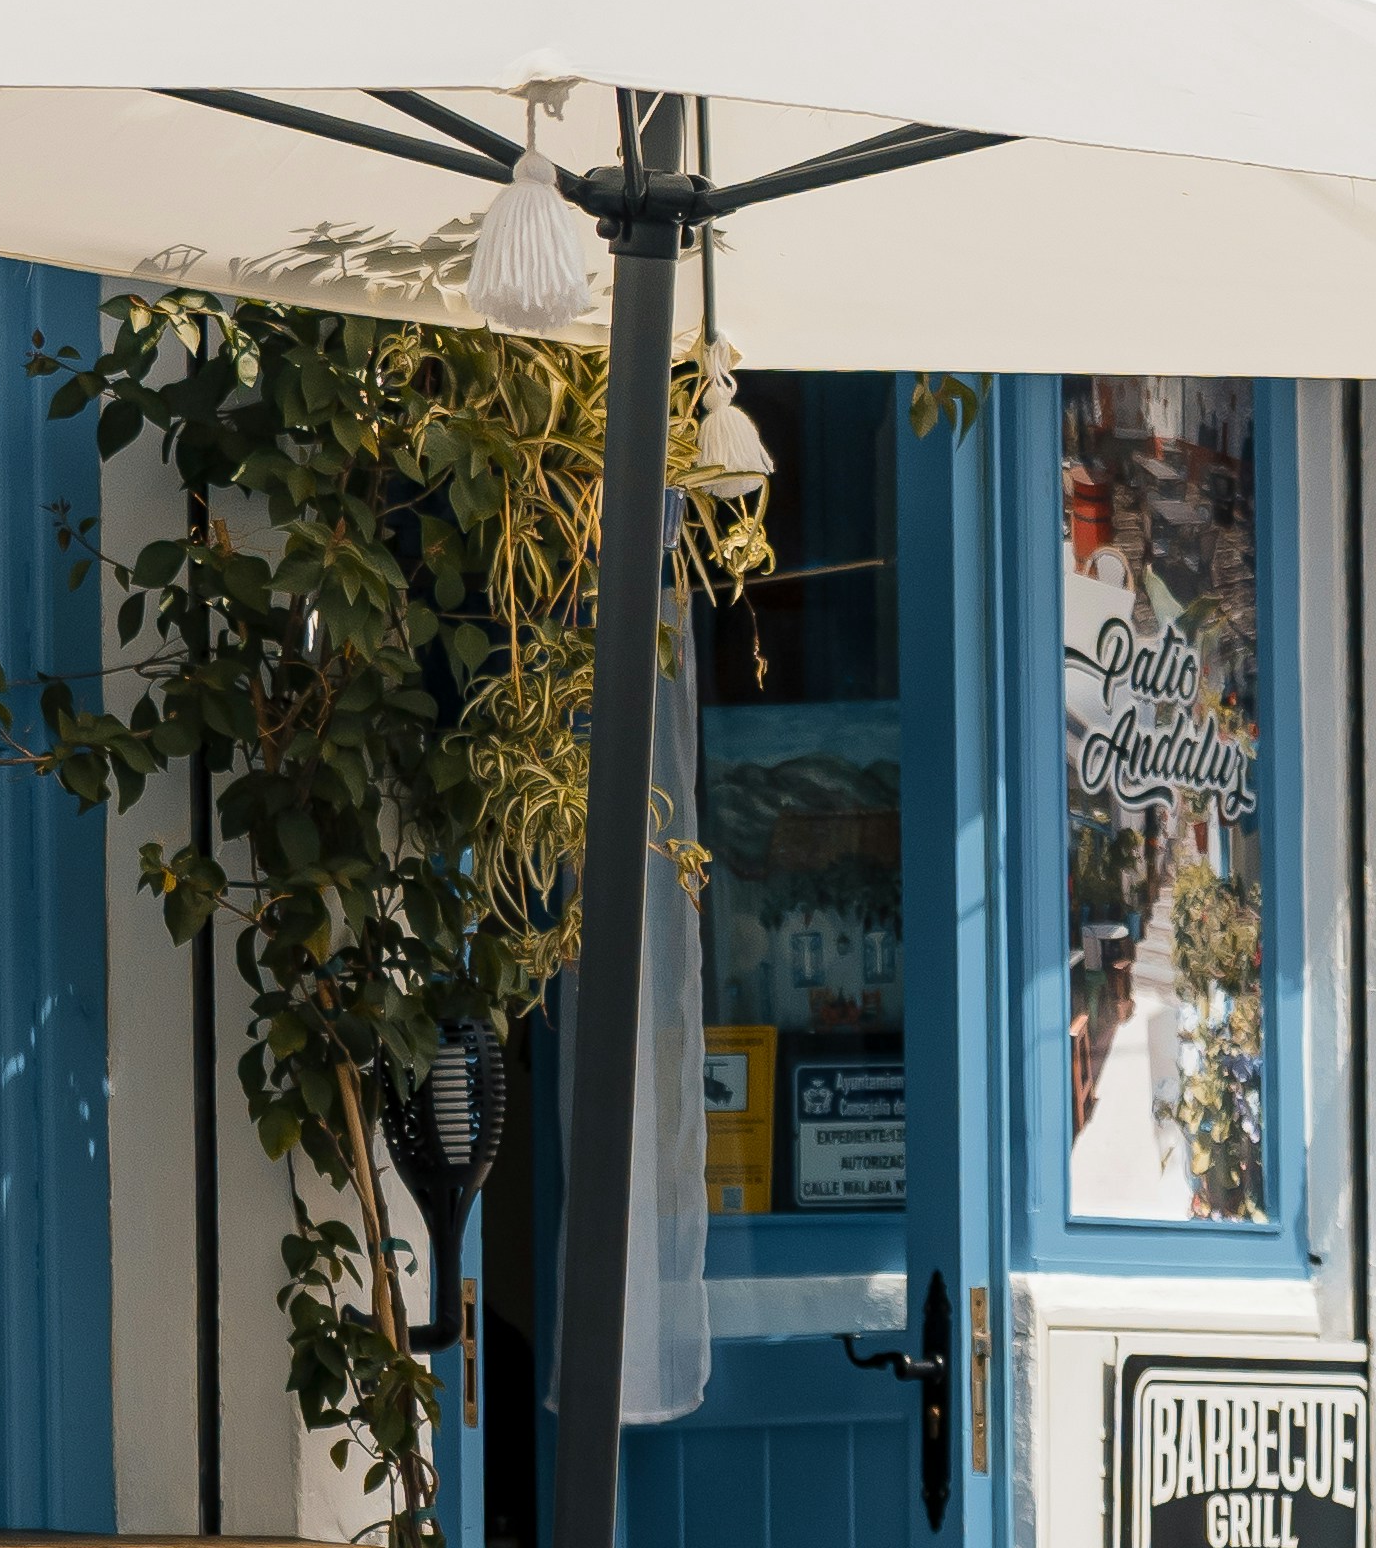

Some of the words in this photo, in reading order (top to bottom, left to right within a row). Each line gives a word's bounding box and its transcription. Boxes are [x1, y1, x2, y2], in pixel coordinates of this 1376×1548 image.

[1064, 617, 1196, 716] Patio
[1081, 704, 1255, 816] Andaluz
[1150, 1397, 1358, 1509] BARBECUE
